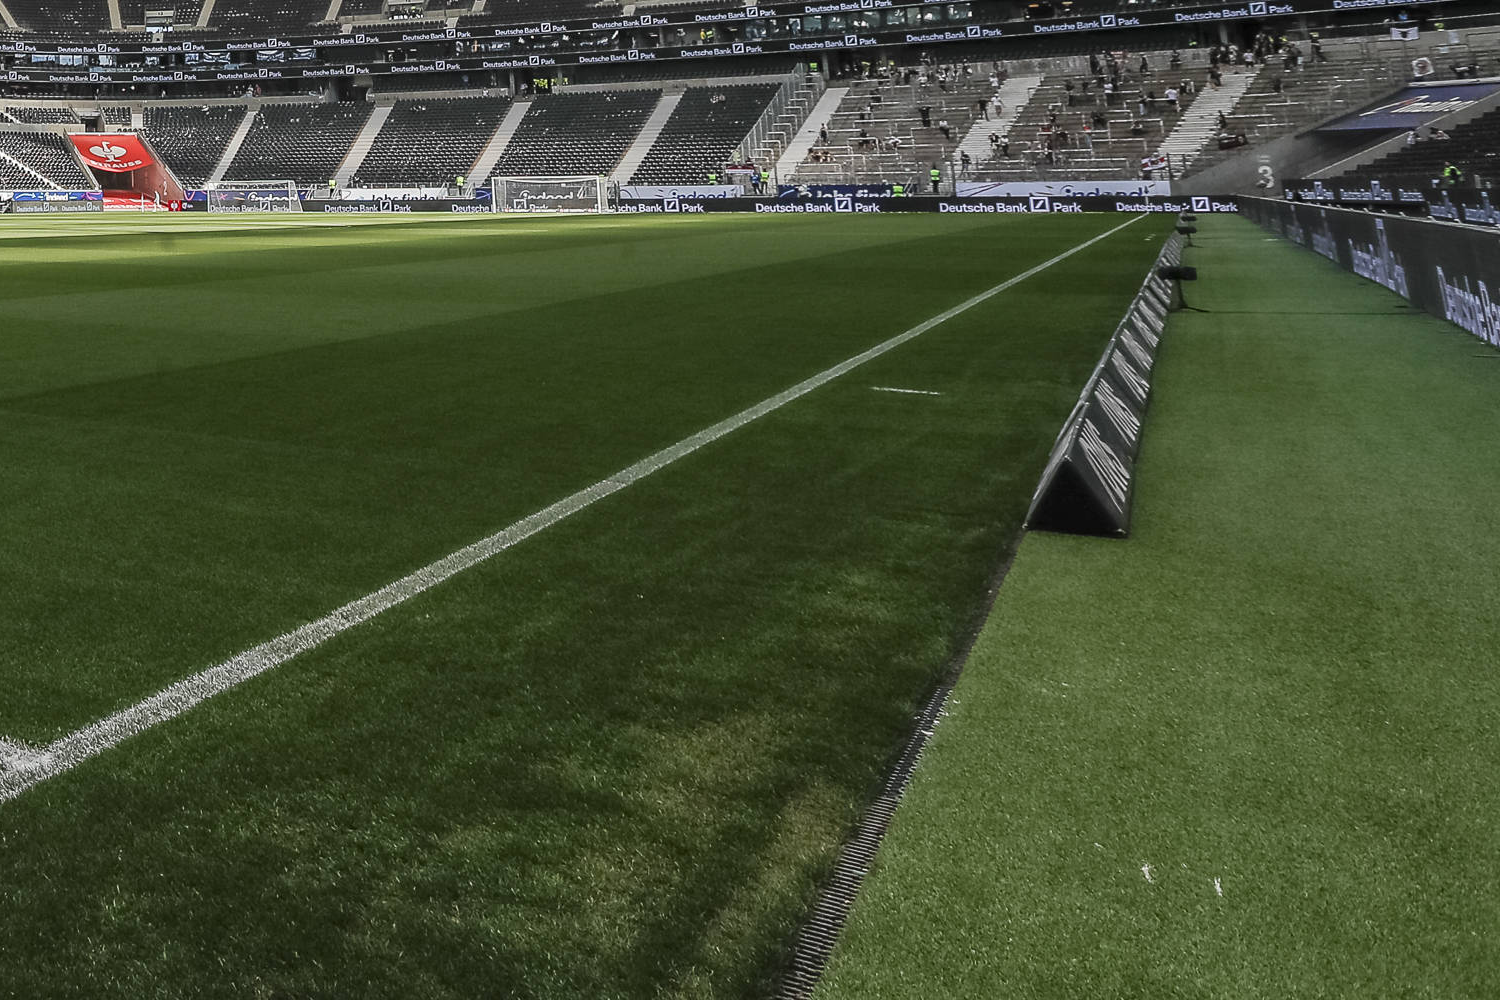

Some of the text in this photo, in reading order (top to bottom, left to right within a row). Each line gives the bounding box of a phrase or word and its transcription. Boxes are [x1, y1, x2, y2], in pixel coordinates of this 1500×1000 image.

[805, 0, 892, 13] Deutsche Bank Park
[696, 9, 776, 22] Deutsche Bank Park
[1176, 5, 1293, 21] Deutsche Bank Park
[1035, 17, 1139, 33] Deutsche Bank Park
[907, 28, 1002, 42] Deutsche Bank Park
[790, 37, 876, 50] Deutsche Bank Park
[681, 45, 762, 57] Deutsche Bank Park
[324, 205, 358, 213] Deutsche
[639, 203, 662, 212] Bank
[682, 203, 704, 212] Park
[755, 203, 881, 213] Deutsche Bank Park
[939, 202, 1082, 213] Deutsche Bank Park
[1116, 202, 1163, 212] Deutsche
[1212, 202, 1238, 212] Park
